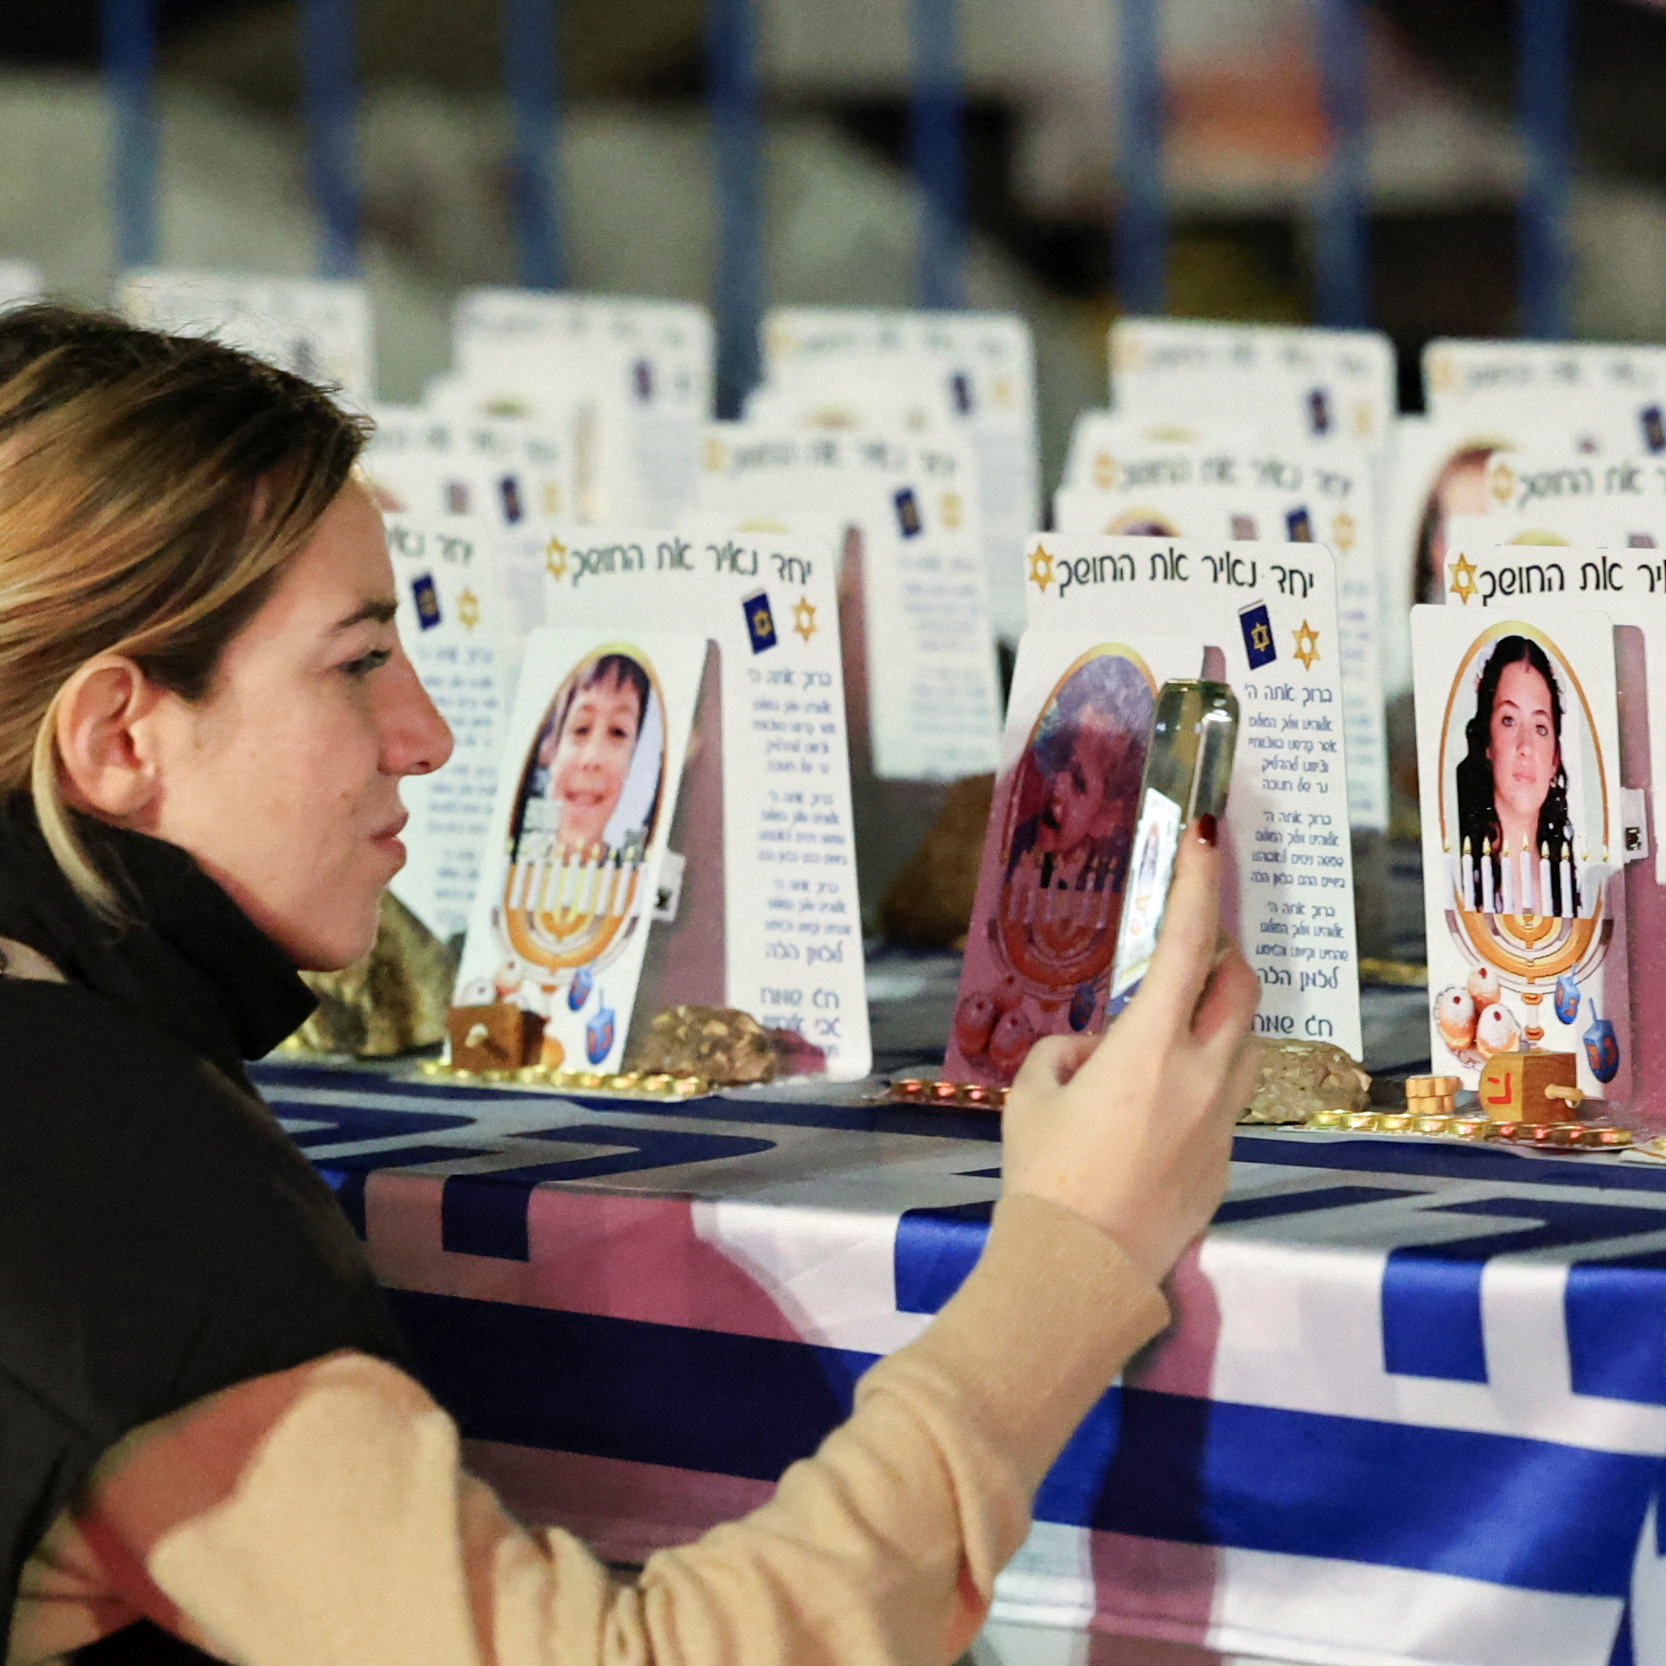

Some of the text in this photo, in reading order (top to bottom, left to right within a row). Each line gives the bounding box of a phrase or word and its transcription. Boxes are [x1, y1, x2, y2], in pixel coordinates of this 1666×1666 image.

[572, 541, 812, 586] יחד נאיר את החושך
[1058, 553, 1314, 599] יחד נאיר את החושך
[1580, 560, 1622, 591] את
[1480, 563, 1565, 607] החושך
[1264, 683, 1295, 702] אתה
[1302, 687, 1333, 708] ברוך
[1300, 966, 1339, 992] לזמן
[1305, 1014, 1333, 1037] חג
